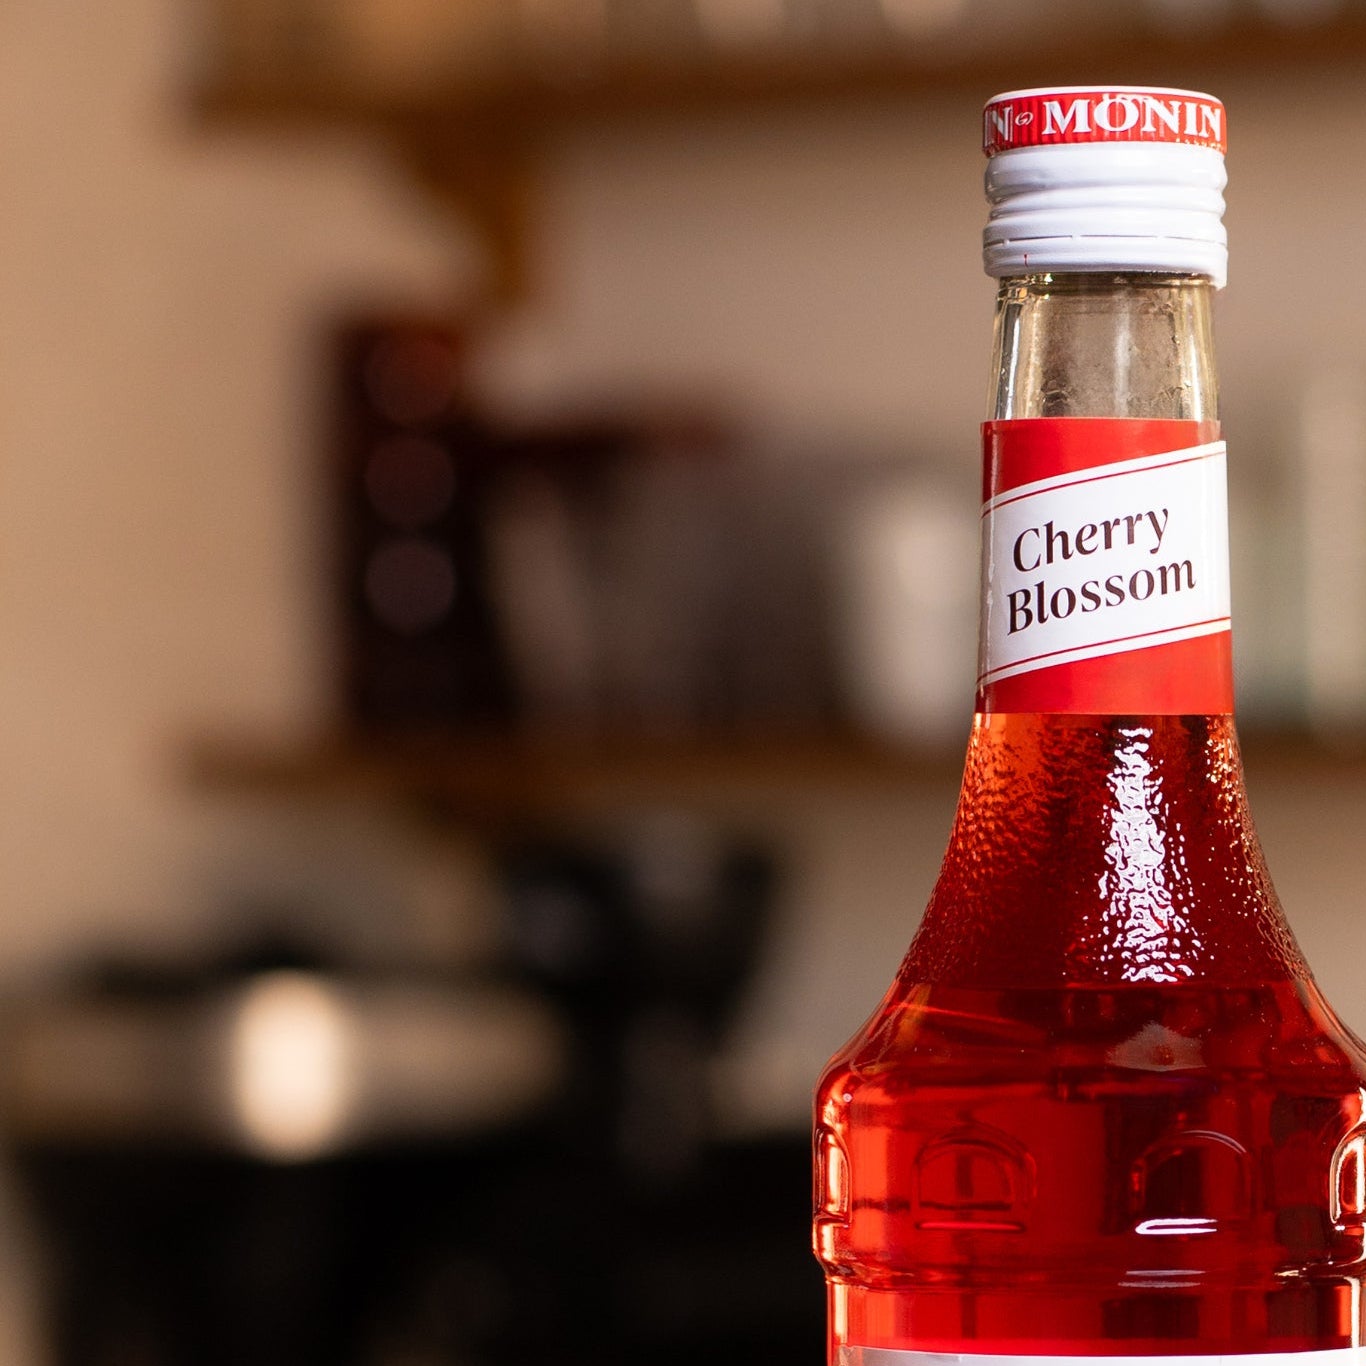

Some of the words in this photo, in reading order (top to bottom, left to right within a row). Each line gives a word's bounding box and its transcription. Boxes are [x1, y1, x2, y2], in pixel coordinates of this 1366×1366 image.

[1042, 97, 1221, 142] MONIN
[1013, 508, 1169, 573] Cherry
[1007, 559, 1197, 636] Blossom
